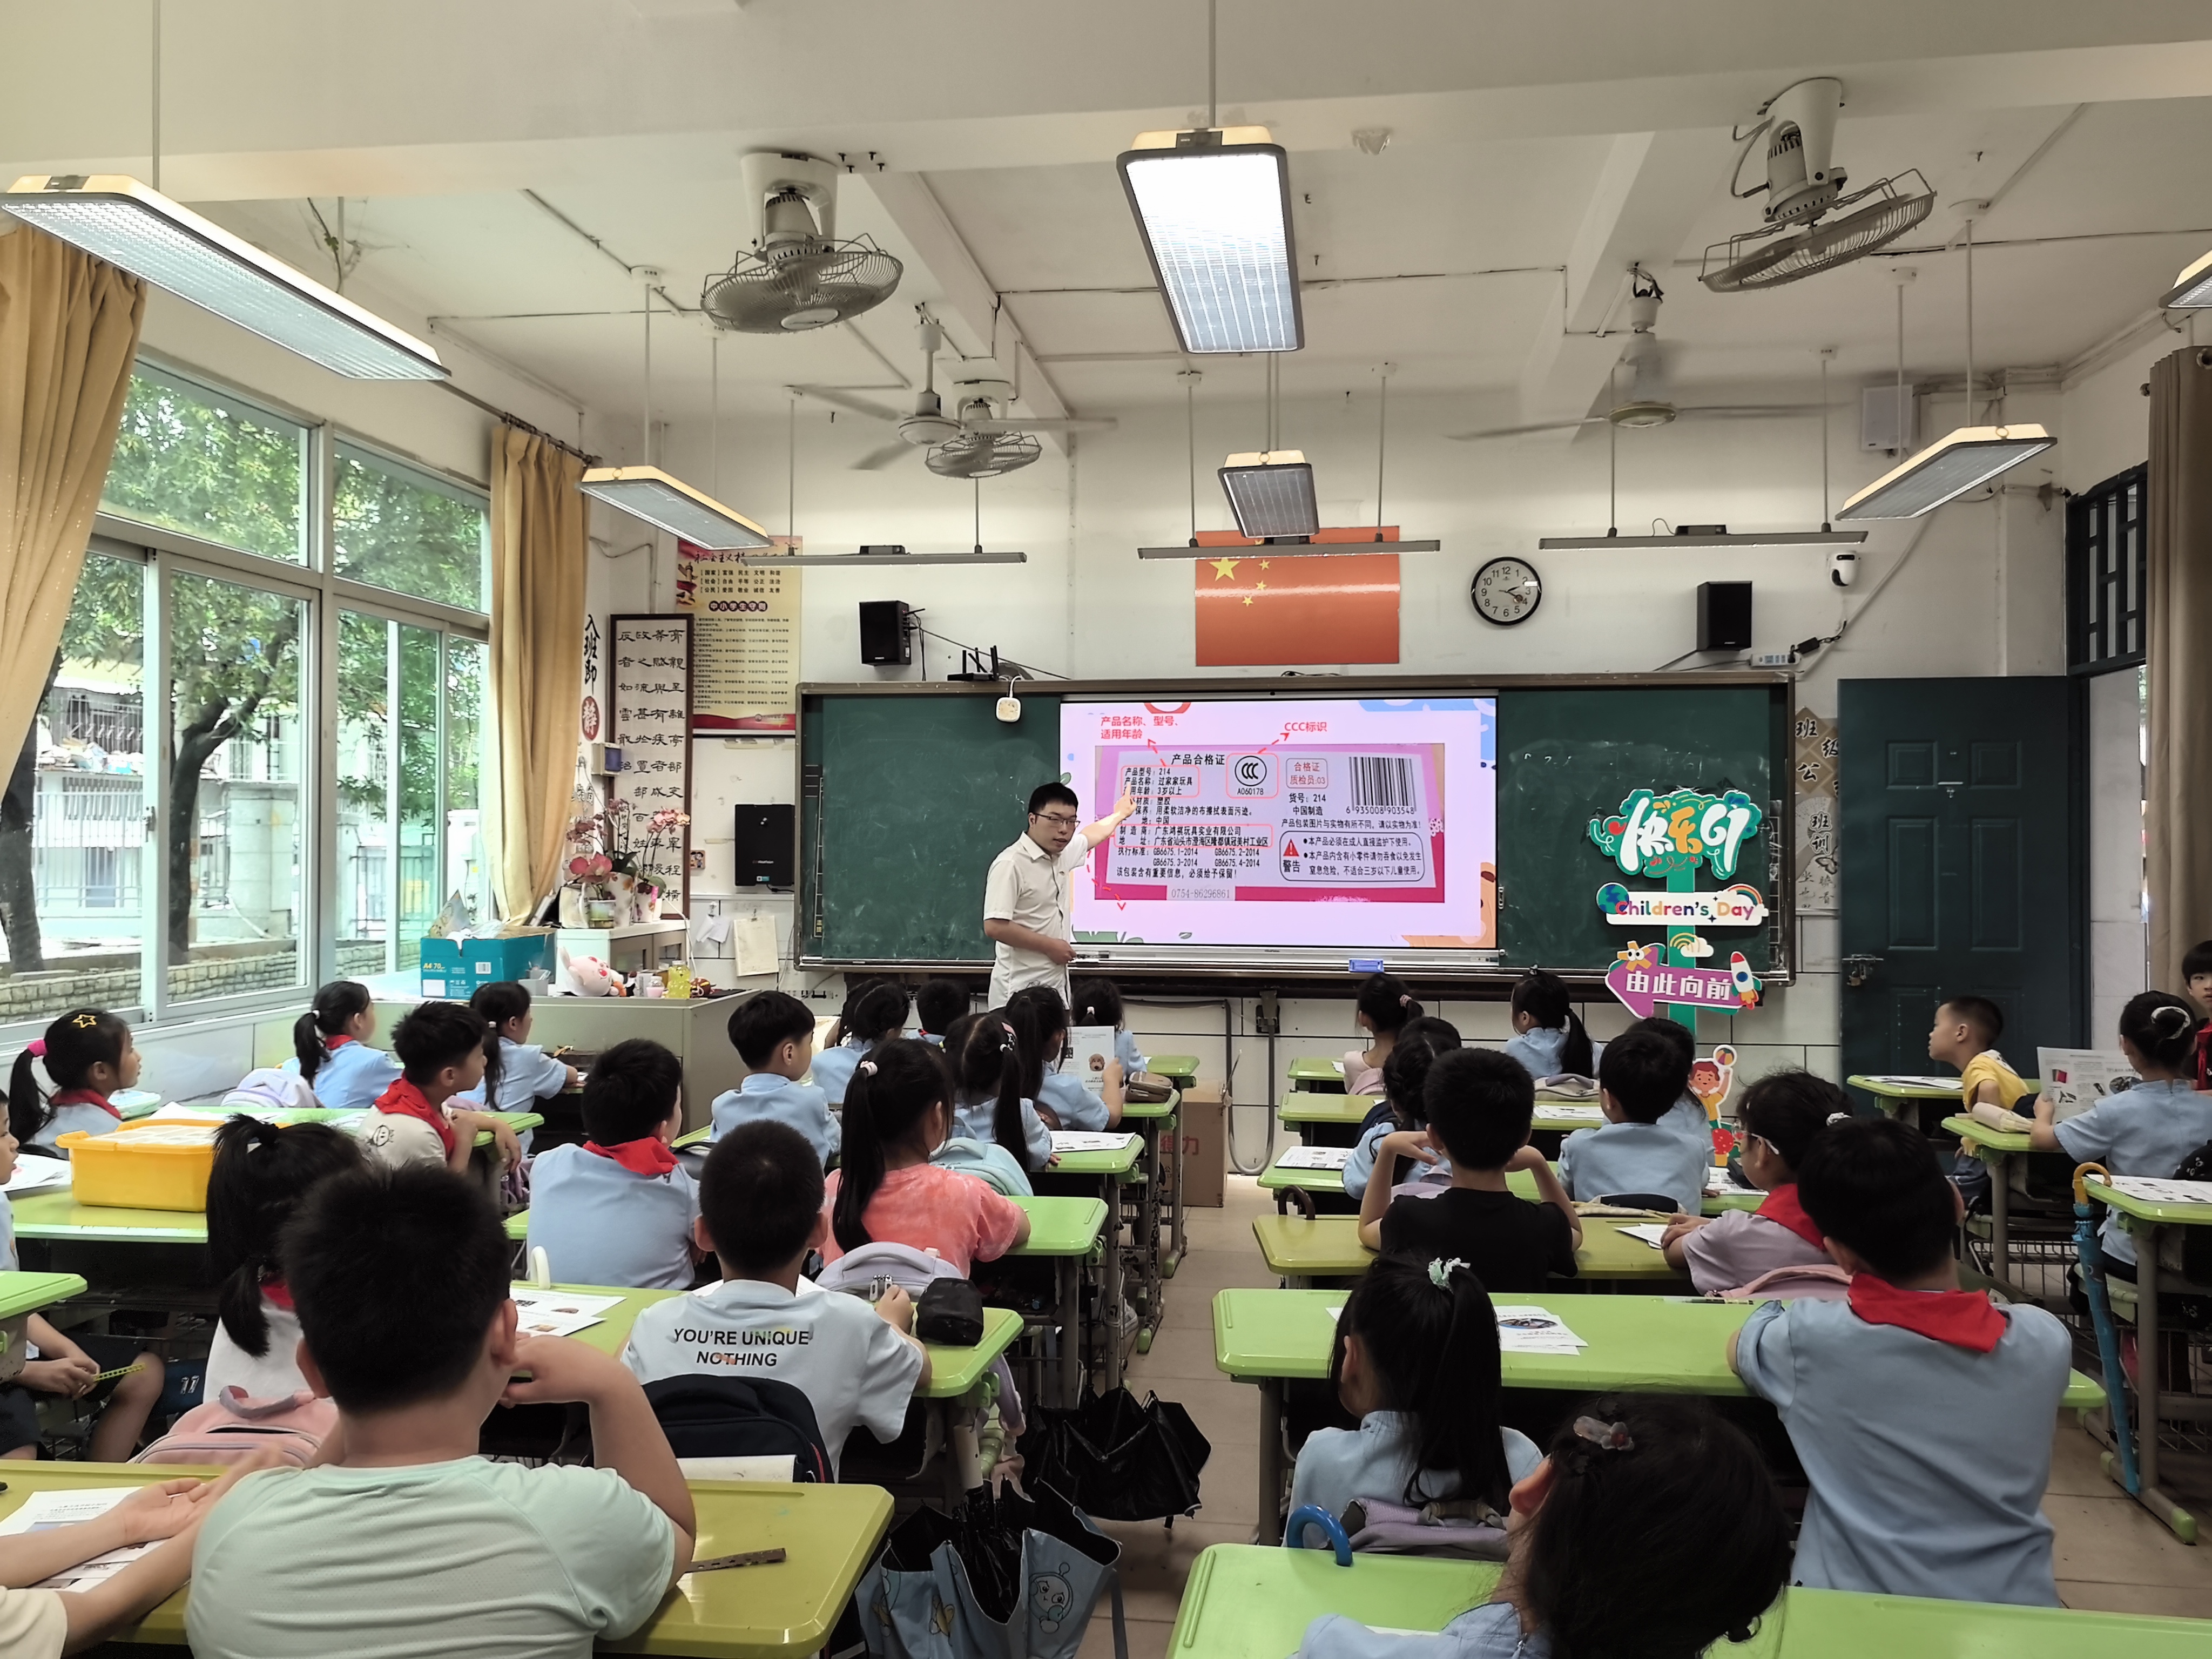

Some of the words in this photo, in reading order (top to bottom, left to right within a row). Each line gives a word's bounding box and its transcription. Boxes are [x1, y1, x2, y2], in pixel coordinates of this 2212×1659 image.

[1502, 567, 1510, 575] 12
[1483, 577, 1492, 585] 10
[1481, 588, 1487, 596] 9
[1526, 587, 1531, 595] 3
[710, 602, 767, 611] 中小学生守则
[1485, 598, 1490, 606] 8
[1503, 609, 1509, 617] 6
[1284, 721, 1327, 732] CCC标识
[1101, 729, 1143, 739] 适用年龄
[1171, 753, 1225, 765] 产品合格证
[1294, 762, 1320, 771] 合格证
[1293, 806, 1323, 815] 中国制造
[1283, 859, 1301, 873] 警告
[1615, 900, 1709, 917] Children's
[1717, 901, 1754, 920] Day
[1626, 970, 1731, 1001] 由此向前
[674, 1328, 737, 1345] YOU'RE
[742, 1331, 809, 1345] UNIQUE
[696, 1351, 777, 1366] NOTHING
